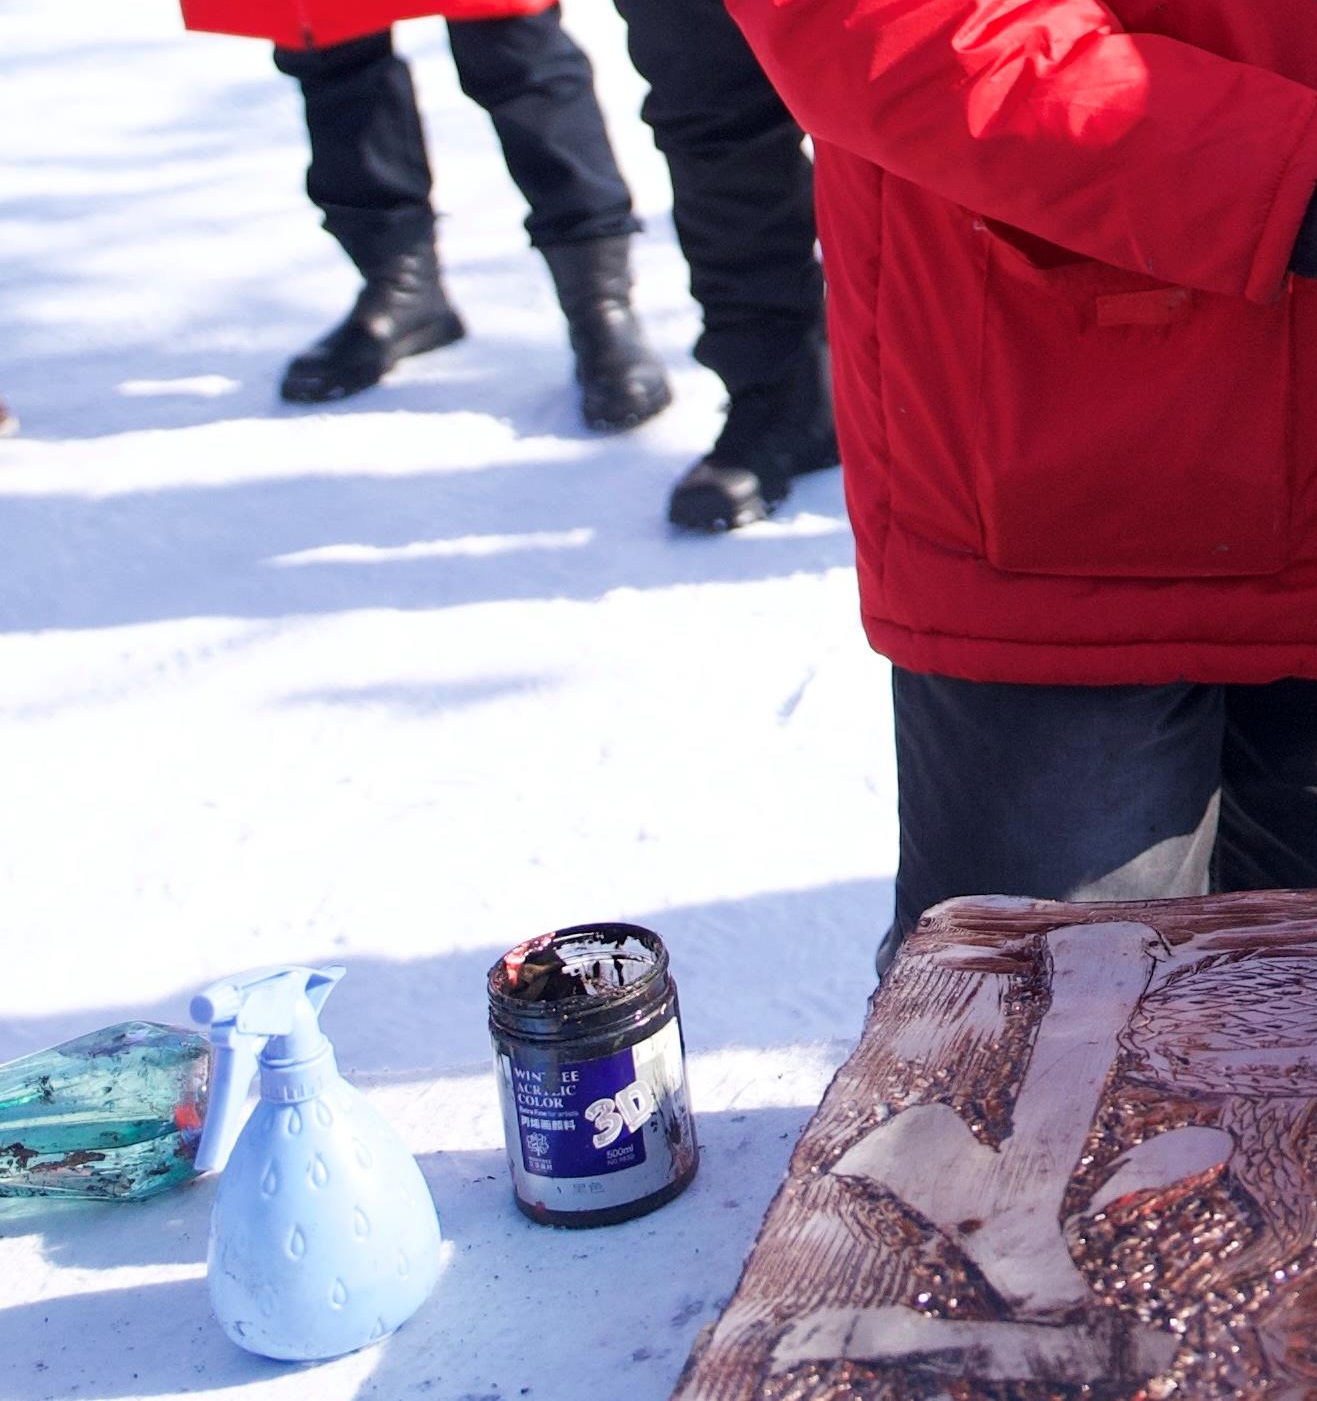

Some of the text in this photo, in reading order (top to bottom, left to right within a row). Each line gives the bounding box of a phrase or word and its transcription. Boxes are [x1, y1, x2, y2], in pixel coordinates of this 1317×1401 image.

[517, 1093, 564, 1109] COLOR
[585, 1079, 655, 1150] 3D
[606, 1143, 634, 1159] 500ml
